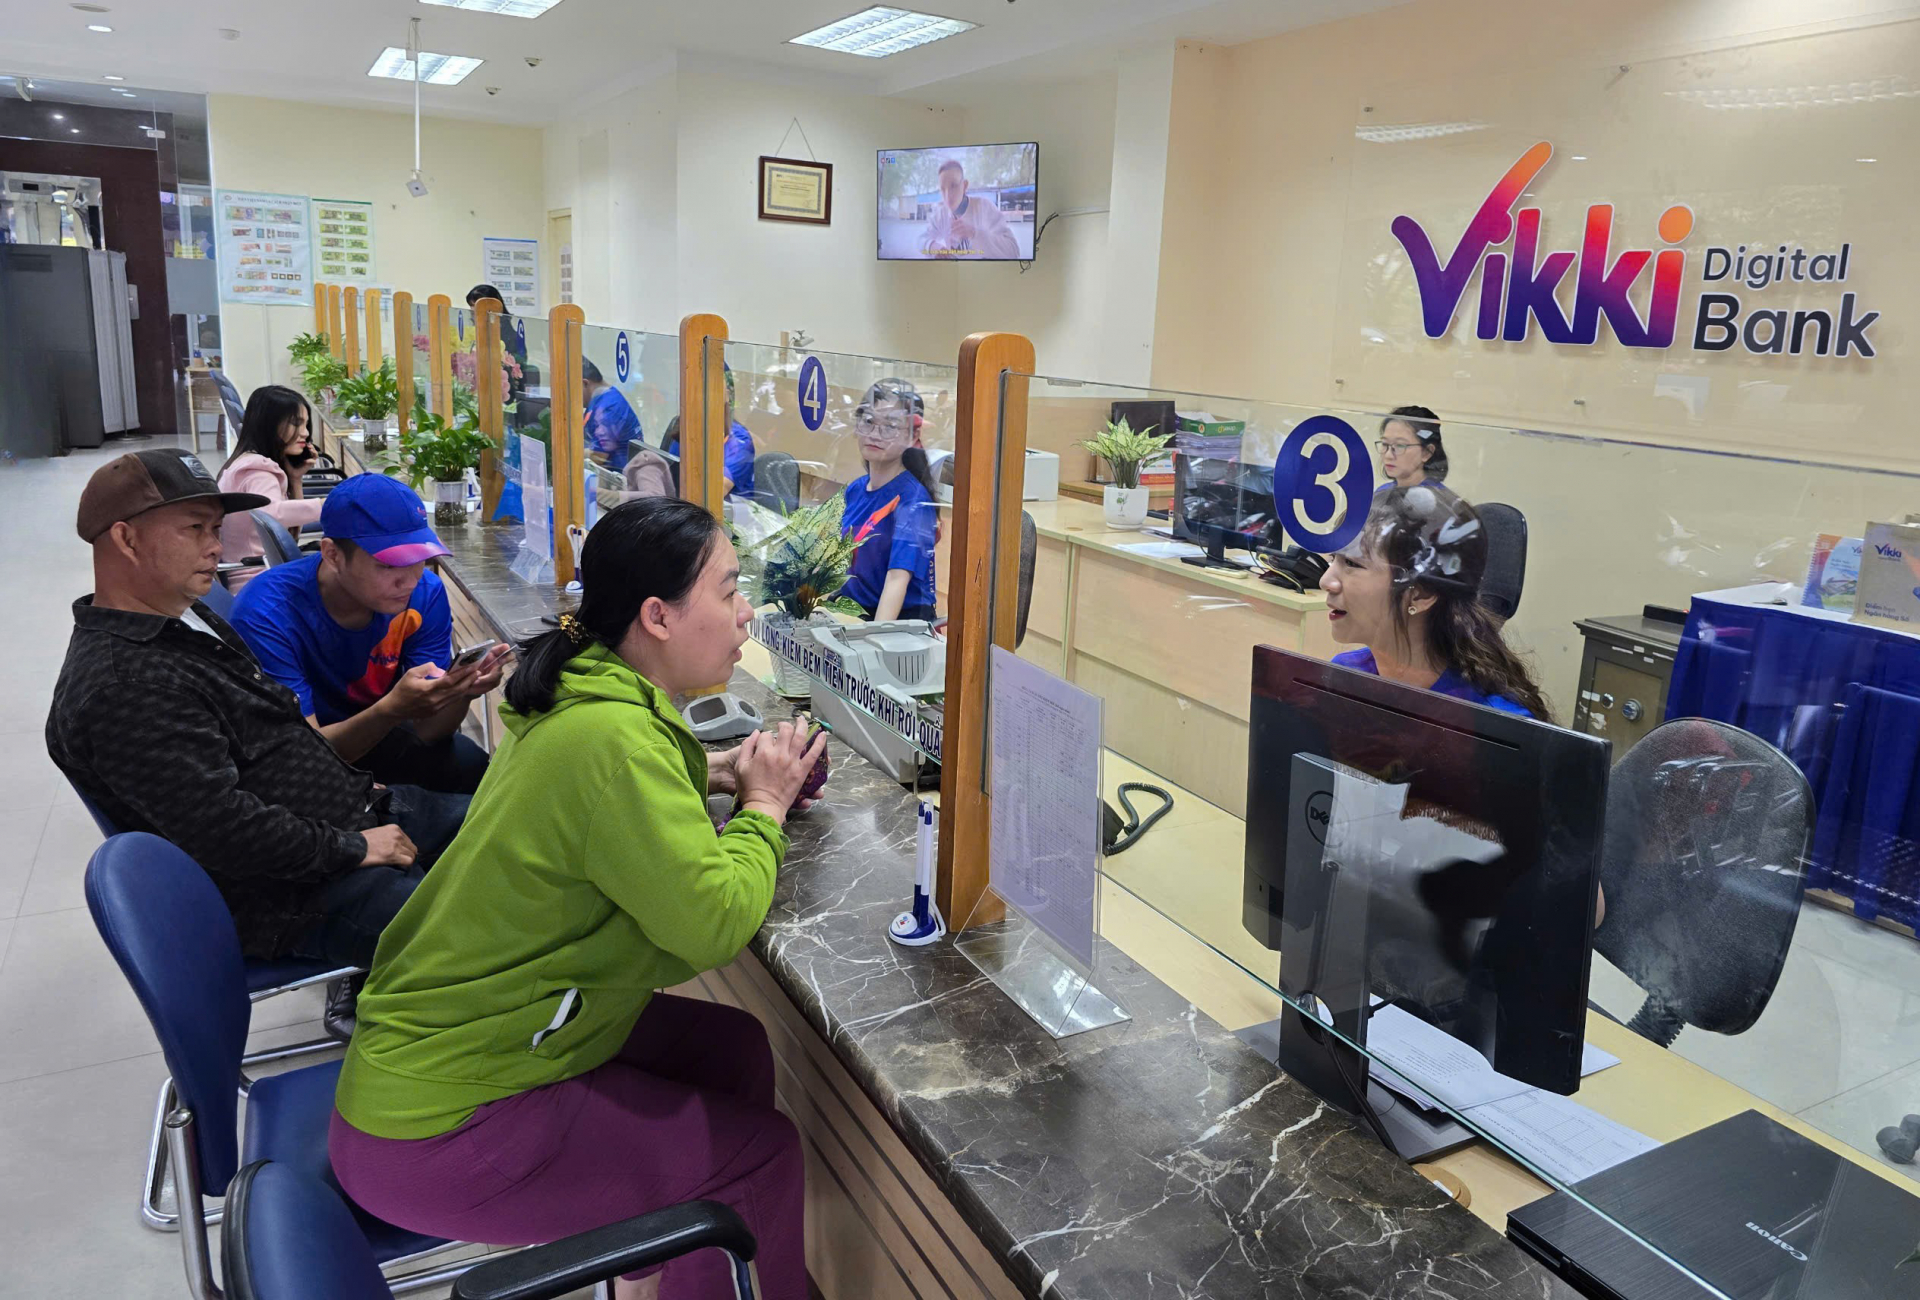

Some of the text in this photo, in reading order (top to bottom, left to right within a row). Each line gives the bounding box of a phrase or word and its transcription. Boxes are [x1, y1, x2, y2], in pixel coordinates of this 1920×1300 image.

[1391, 141, 1694, 348] Vikki
[1703, 243, 1850, 289] Digital
[1693, 292, 1880, 358] Bank
[617, 338, 627, 377] 5
[803, 366, 821, 421] 4
[1292, 432, 1351, 536] 3
[1875, 543, 1902, 558] Vikki
[803, 643, 821, 678] ĐẾM
[845, 673, 876, 713] TRƯỚC
[878, 694, 895, 726] KHI
[898, 701, 916, 740] RỜI
[1745, 1221, 1808, 1261] Canon
